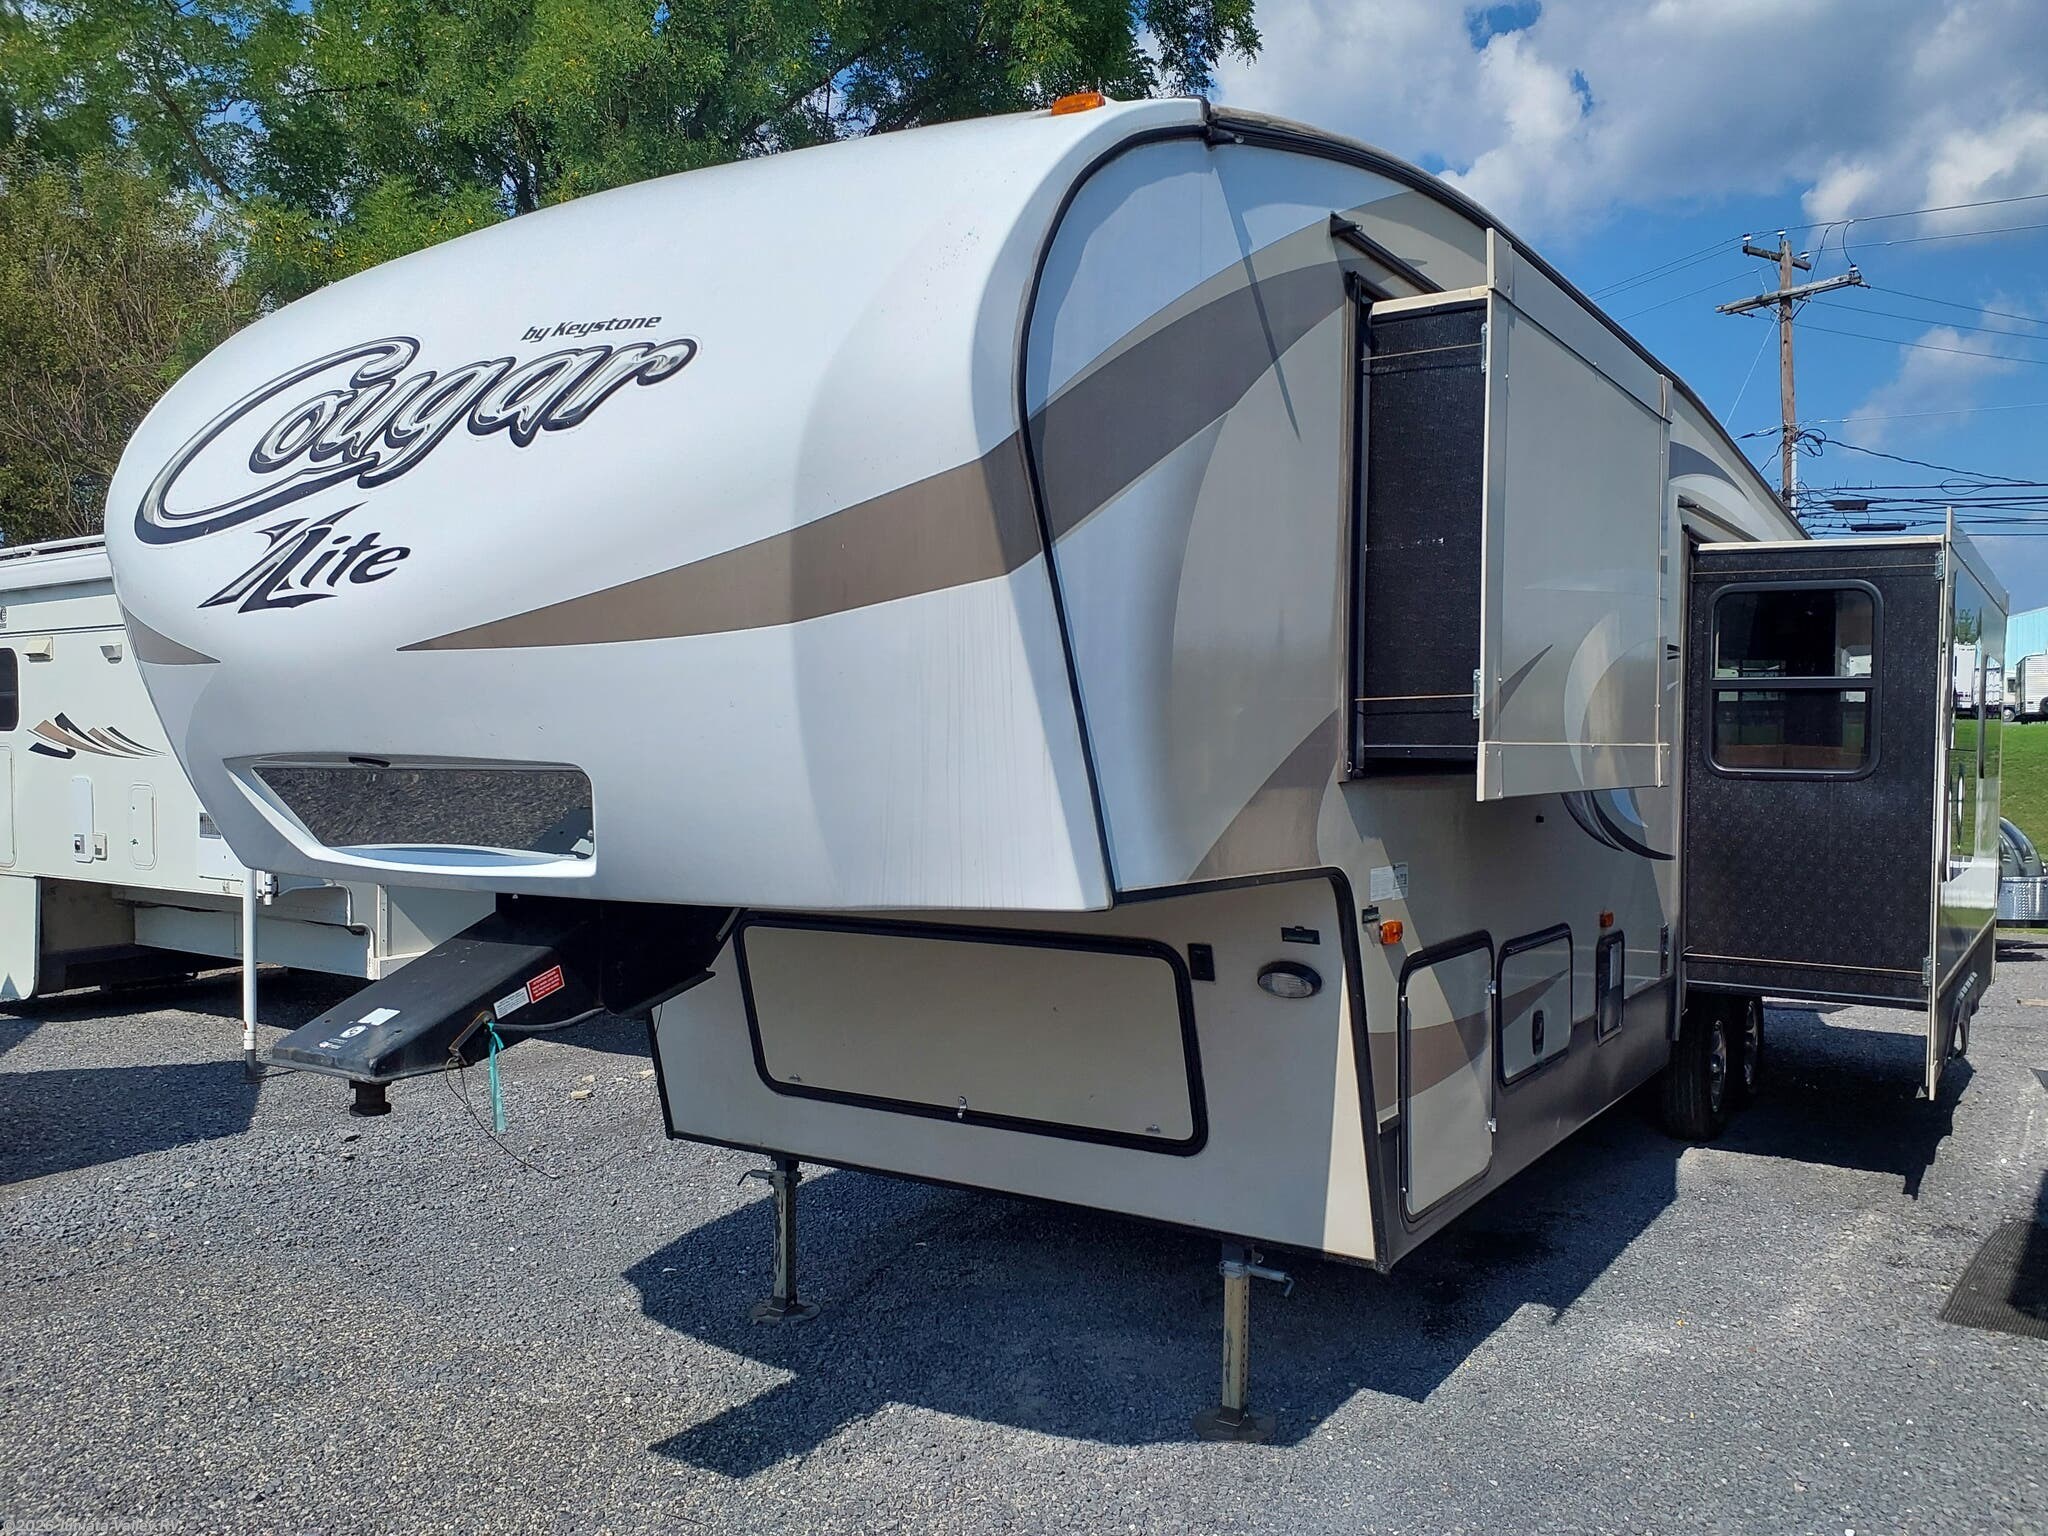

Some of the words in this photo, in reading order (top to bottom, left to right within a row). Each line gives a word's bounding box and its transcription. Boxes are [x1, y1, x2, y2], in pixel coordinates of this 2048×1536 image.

[520, 326, 551, 344] by
[550, 316, 662, 339] Keystone
[134, 336, 698, 545] Cougar
